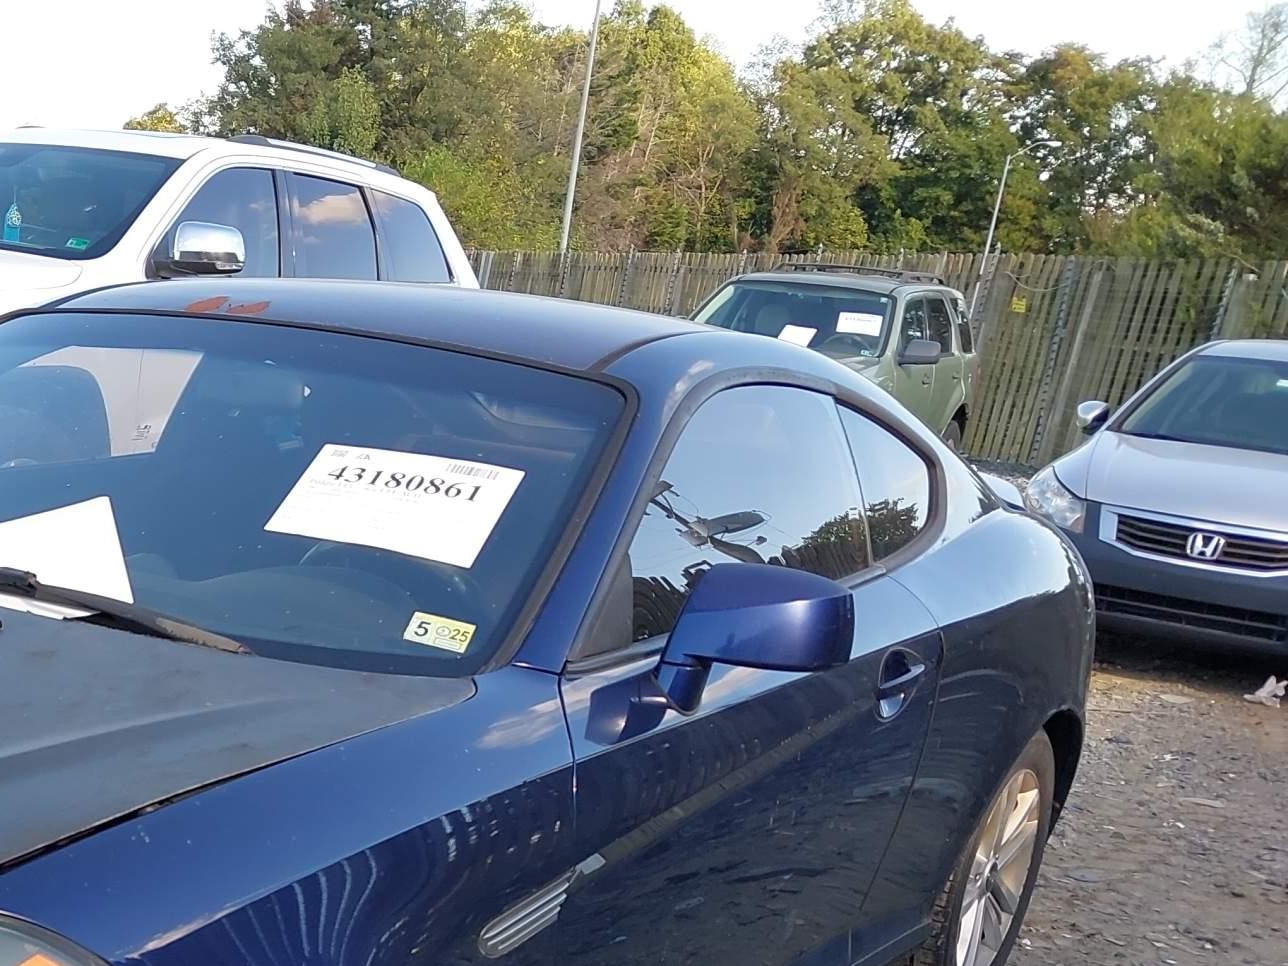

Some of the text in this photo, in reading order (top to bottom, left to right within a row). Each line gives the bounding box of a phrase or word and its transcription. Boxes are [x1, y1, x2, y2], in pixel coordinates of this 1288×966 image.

[327, 465, 482, 502] 43180861
[414, 620, 470, 643] 5 25
